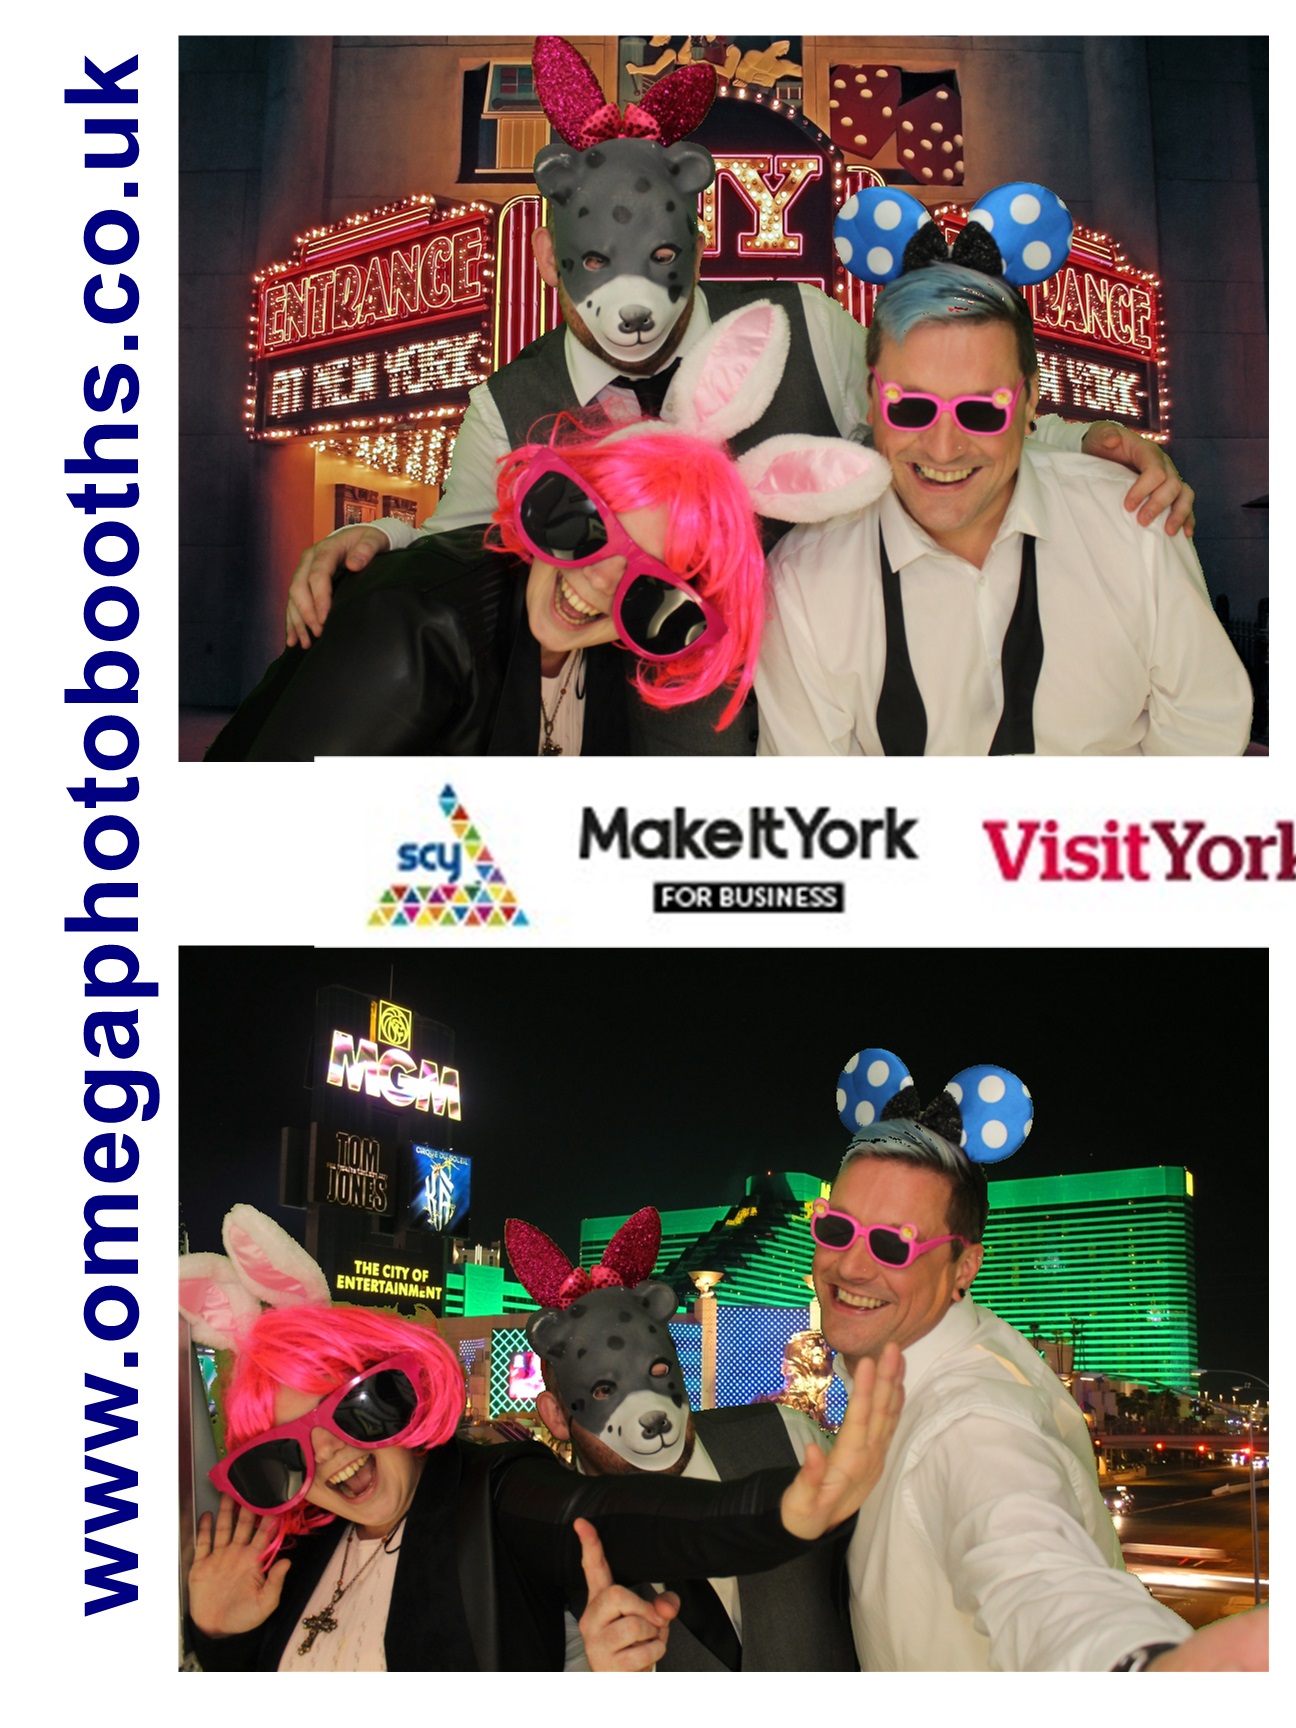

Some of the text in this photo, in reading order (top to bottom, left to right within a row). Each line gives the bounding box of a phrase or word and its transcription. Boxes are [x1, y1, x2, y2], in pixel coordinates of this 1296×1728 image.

[263, 226, 483, 347] ENTRANCE
[1023, 268, 1152, 350] RANCE
[271, 366, 307, 418] AT
[384, 330, 484, 398] YORK
[326, 1029, 462, 1121] MGM
[336, 1132, 381, 1173] TOM
[327, 1167, 388, 1213] JONES
[336, 1274, 443, 1300] ENTERTAINMENT
[354, 1260, 430, 1282] THE CITY OF
